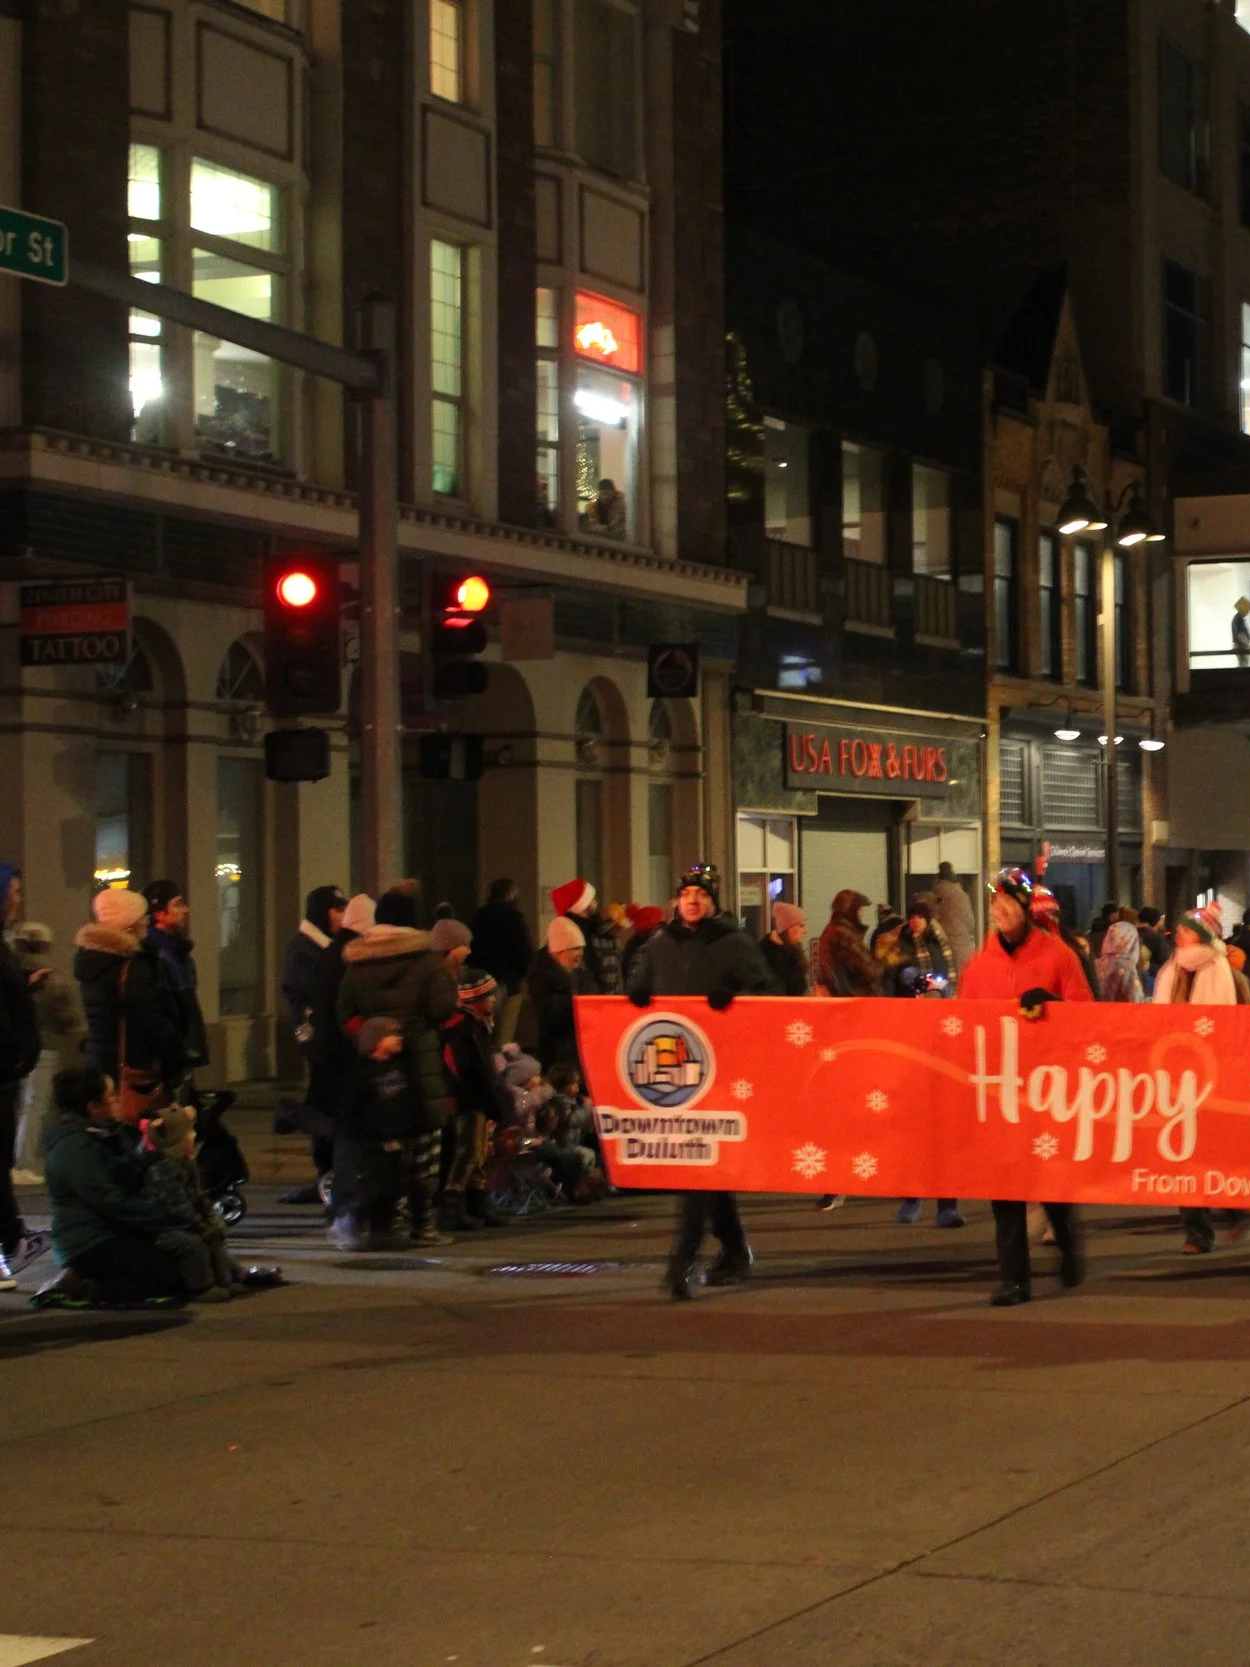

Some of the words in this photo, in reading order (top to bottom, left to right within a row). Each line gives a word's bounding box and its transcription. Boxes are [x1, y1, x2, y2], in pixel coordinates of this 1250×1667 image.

[27, 231, 54, 267] St
[28, 635, 120, 661] TATTOO
[790, 733, 833, 775] USA
[902, 744, 947, 783] FURS
[968, 1016, 1214, 1162] Happy
[600, 1113, 741, 1136] Downtown
[627, 1138, 712, 1160] Duluth
[1131, 1168, 1197, 1195] From
